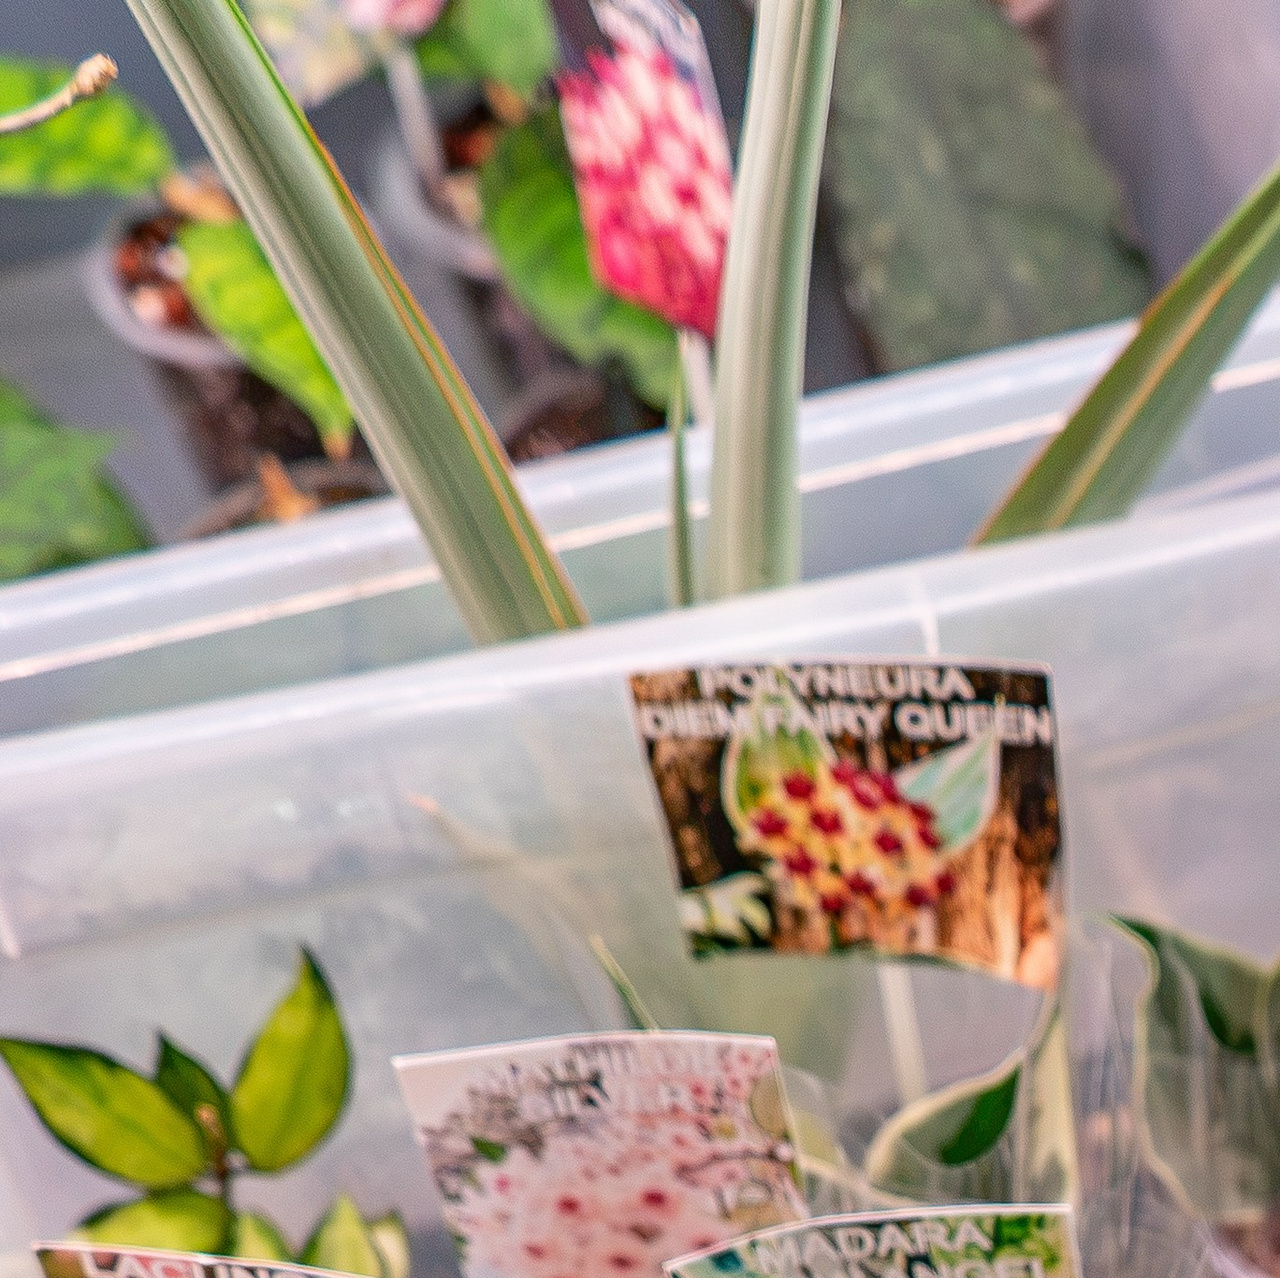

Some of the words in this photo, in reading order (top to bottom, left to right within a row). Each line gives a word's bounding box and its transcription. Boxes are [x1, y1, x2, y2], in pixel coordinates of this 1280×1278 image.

[703, 663, 976, 701] POLYNEURA
[893, 700, 1053, 745] QUEEN
[754, 1220, 994, 1275] MADARA
